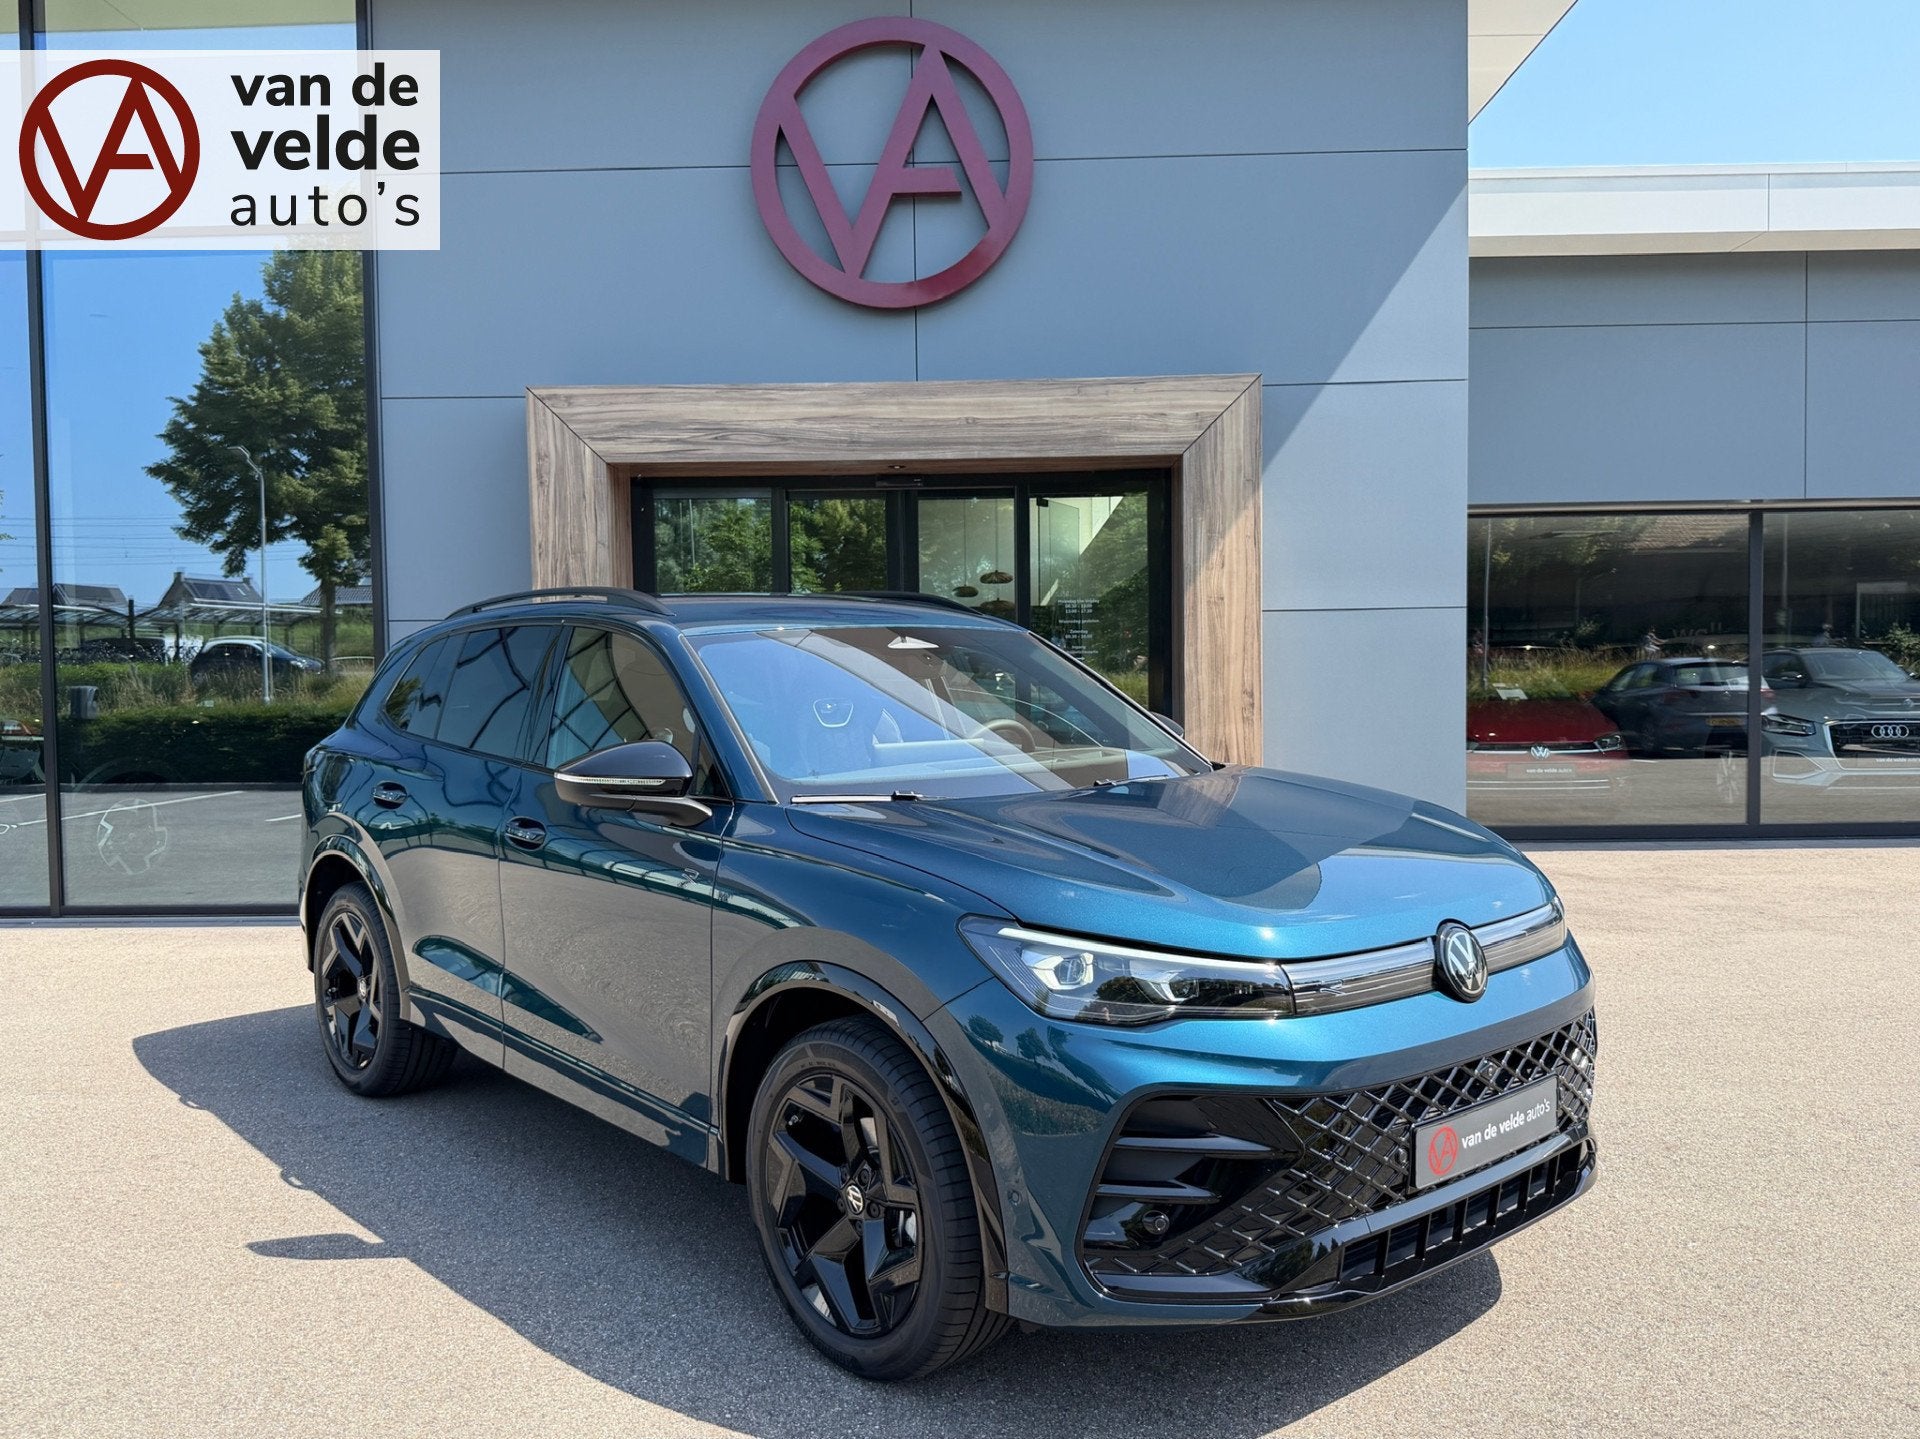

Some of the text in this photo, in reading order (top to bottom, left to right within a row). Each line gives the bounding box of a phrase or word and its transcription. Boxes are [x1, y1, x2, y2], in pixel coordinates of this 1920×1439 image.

[1462, 1098, 1550, 1149] van de velde auto's
